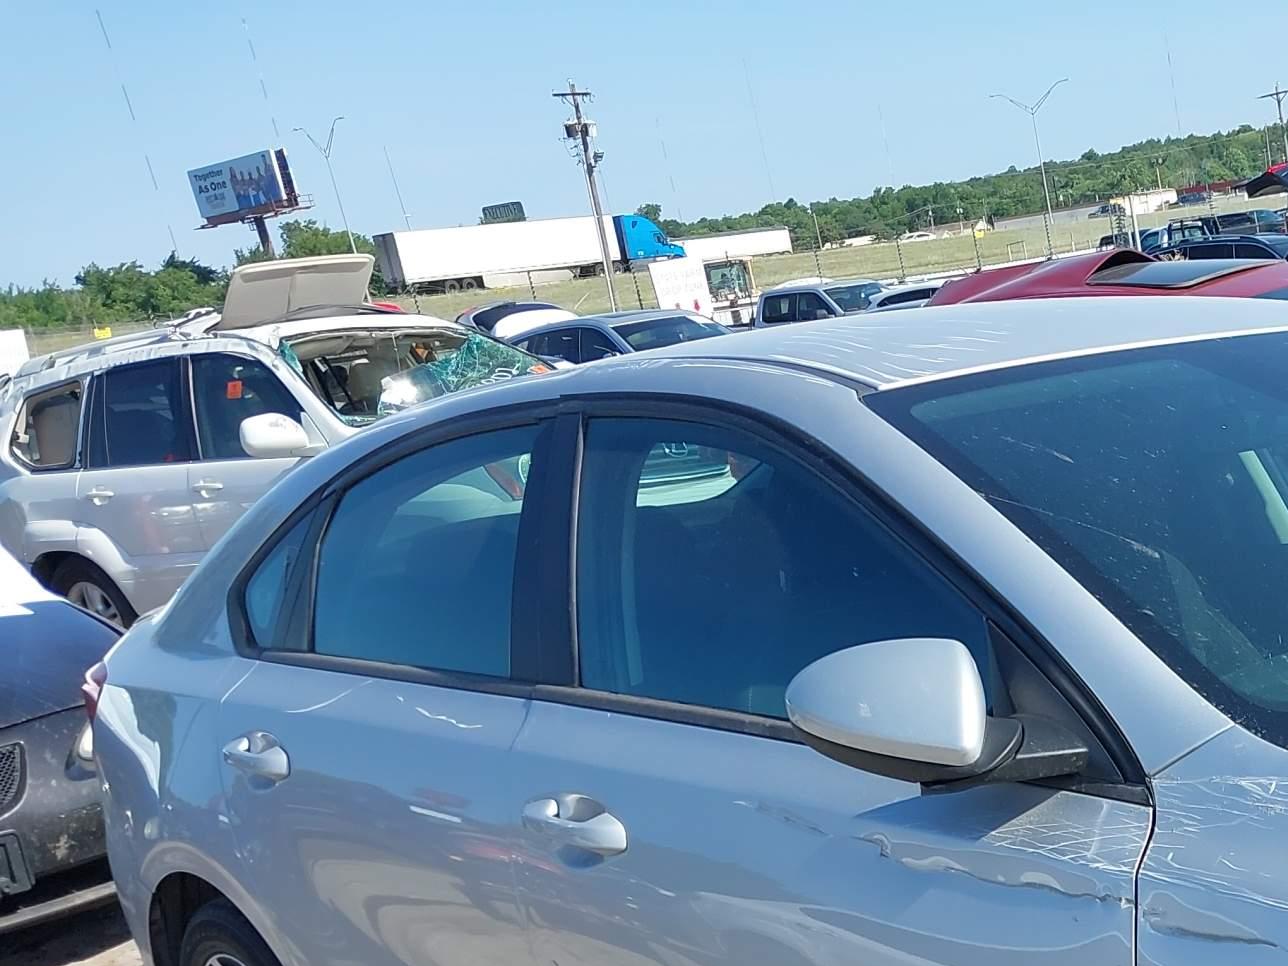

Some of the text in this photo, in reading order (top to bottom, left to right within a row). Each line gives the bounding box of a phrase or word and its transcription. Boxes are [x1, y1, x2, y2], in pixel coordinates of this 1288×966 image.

[193, 168, 223, 182] Together
[198, 180, 227, 194] As One
